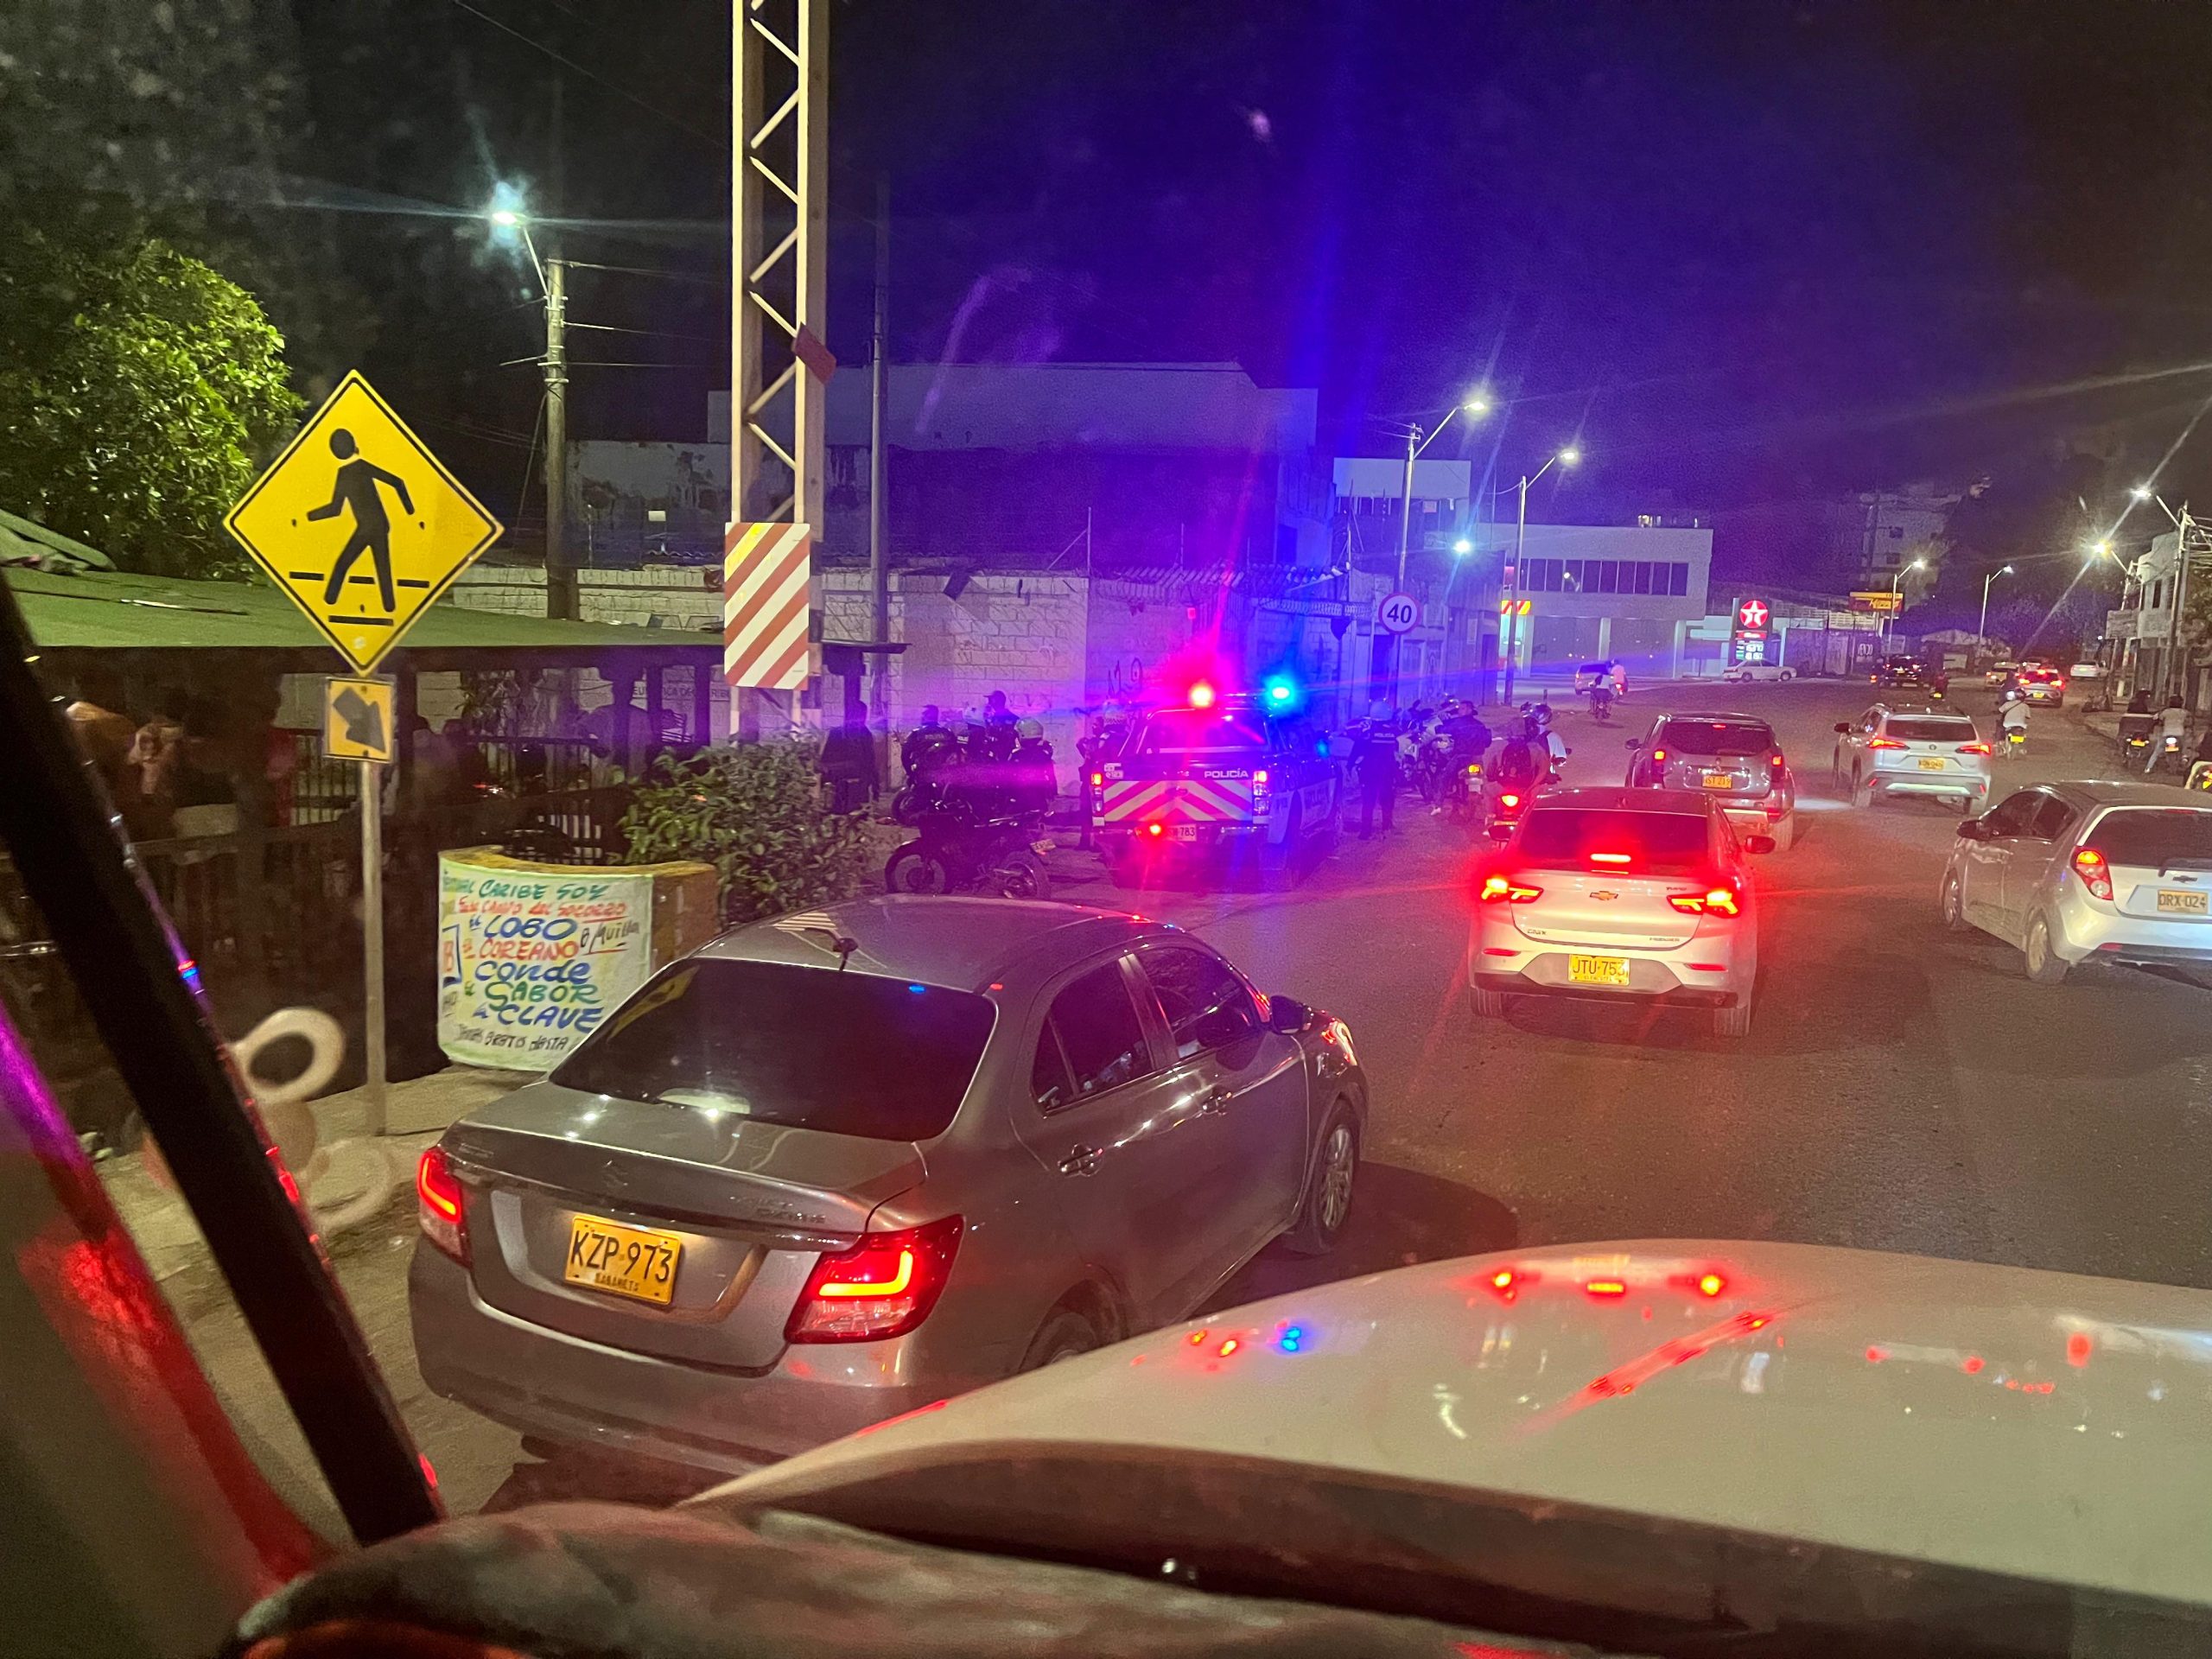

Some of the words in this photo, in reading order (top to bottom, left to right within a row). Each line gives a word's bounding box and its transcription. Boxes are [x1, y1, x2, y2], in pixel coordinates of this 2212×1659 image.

[1387, 603, 1413, 624] 40
[1204, 767, 1249, 779] POLICÍA
[479, 880, 550, 900] CARIBE
[556, 883, 610, 901] SOY
[483, 914, 578, 941] LOBO
[480, 938, 580, 961] COREANO
[485, 982, 602, 1012] SABOR
[498, 1003, 604, 1034] CLAVE
